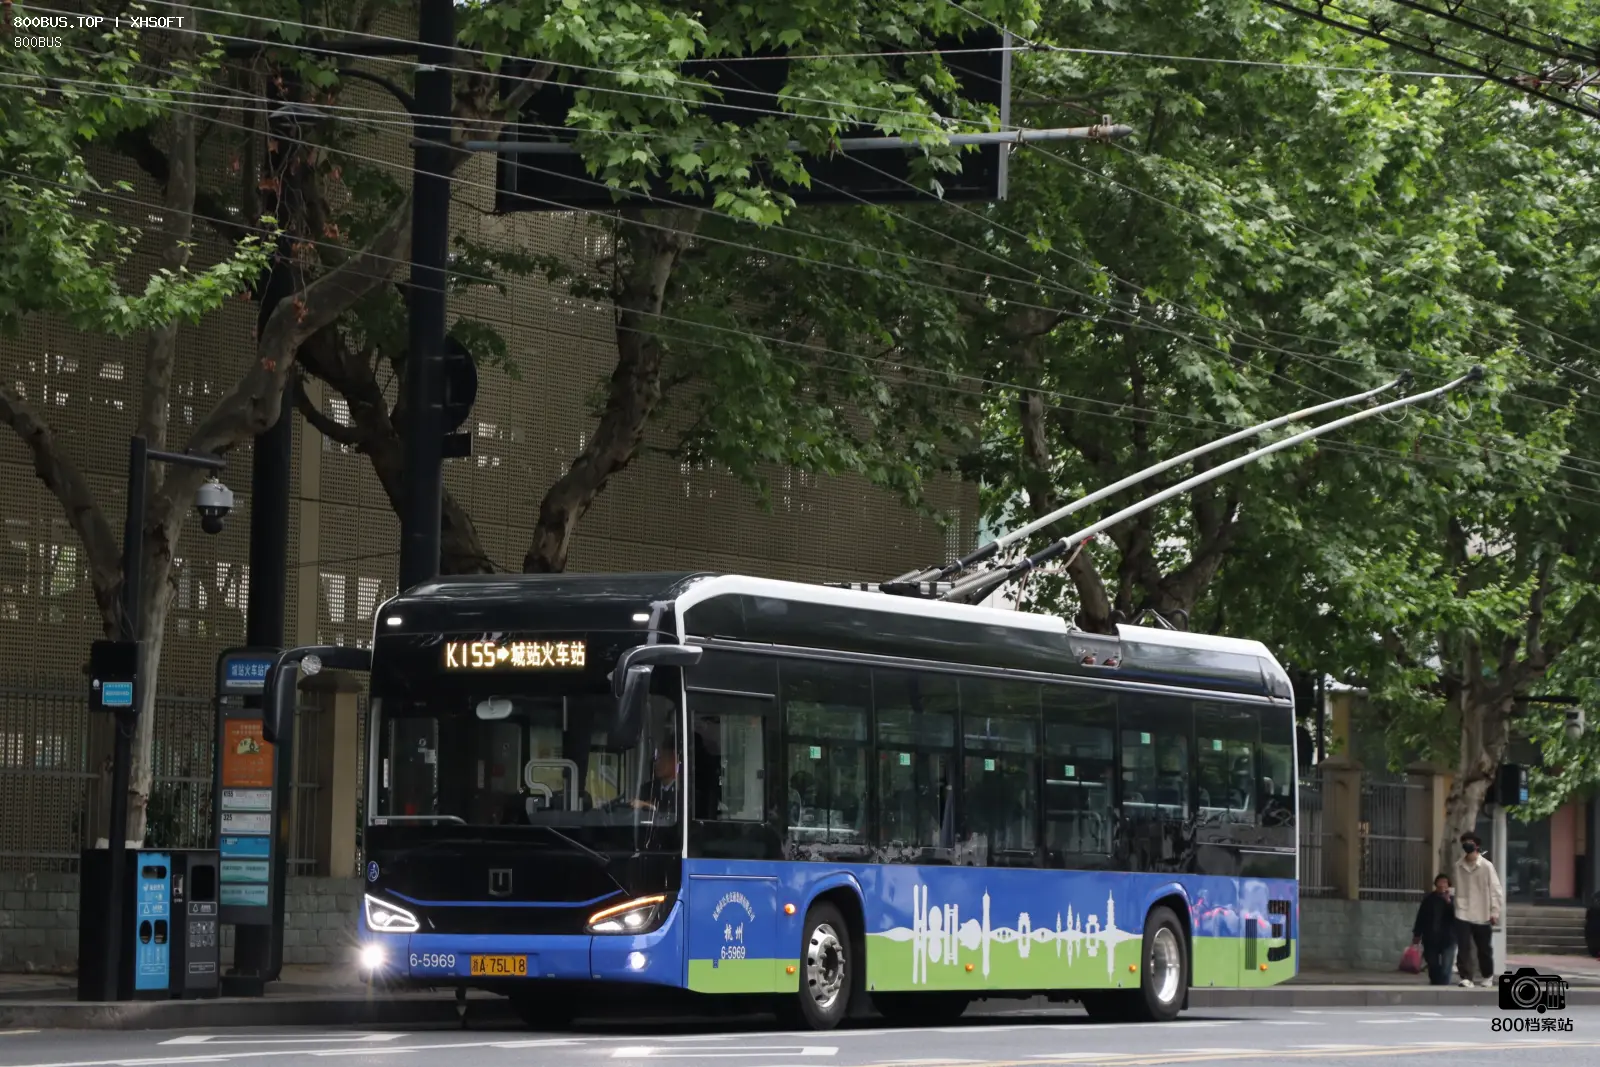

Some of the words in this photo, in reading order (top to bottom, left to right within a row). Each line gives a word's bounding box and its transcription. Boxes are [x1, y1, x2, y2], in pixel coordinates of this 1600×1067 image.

[446, 642, 496, 668] K155
[510, 641, 586, 667] 城站火车站
[409, 952, 456, 968] 6-5969
[720, 945, 746, 960] 6-5969
